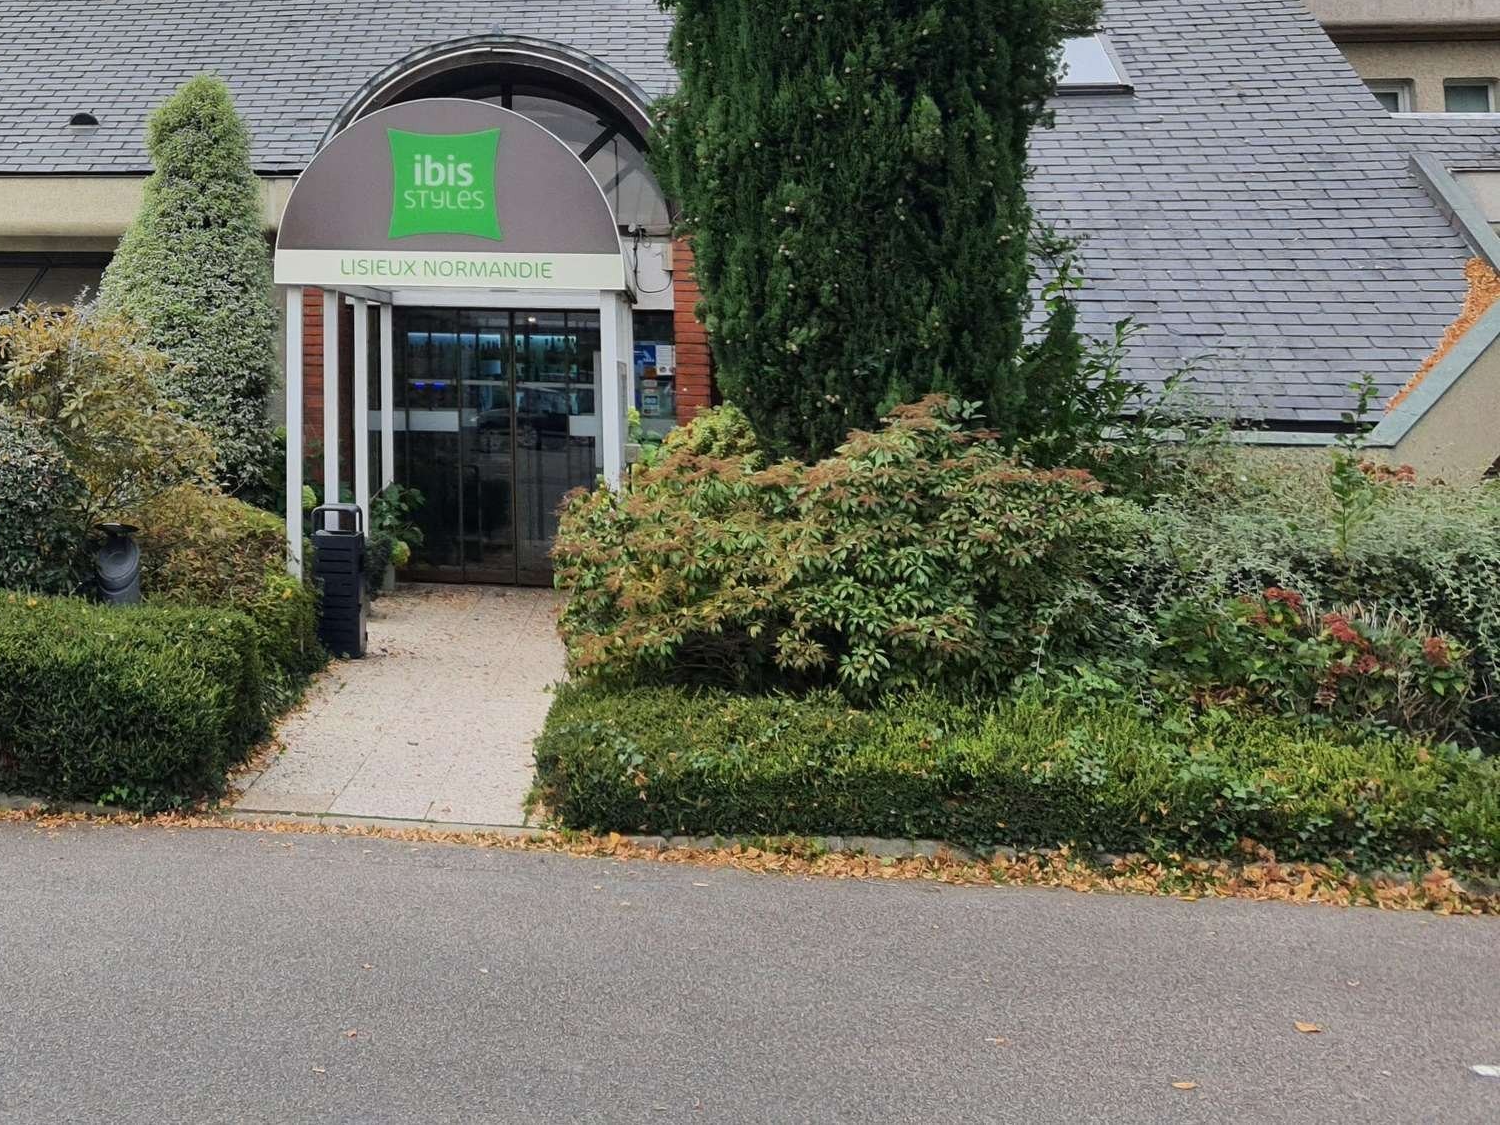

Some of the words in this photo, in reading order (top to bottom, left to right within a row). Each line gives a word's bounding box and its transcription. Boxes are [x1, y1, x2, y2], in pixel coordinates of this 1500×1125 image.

[413, 153, 475, 187] ibis
[340, 258, 417, 276] LISIEUX
[423, 259, 554, 280] NORMANDIE
